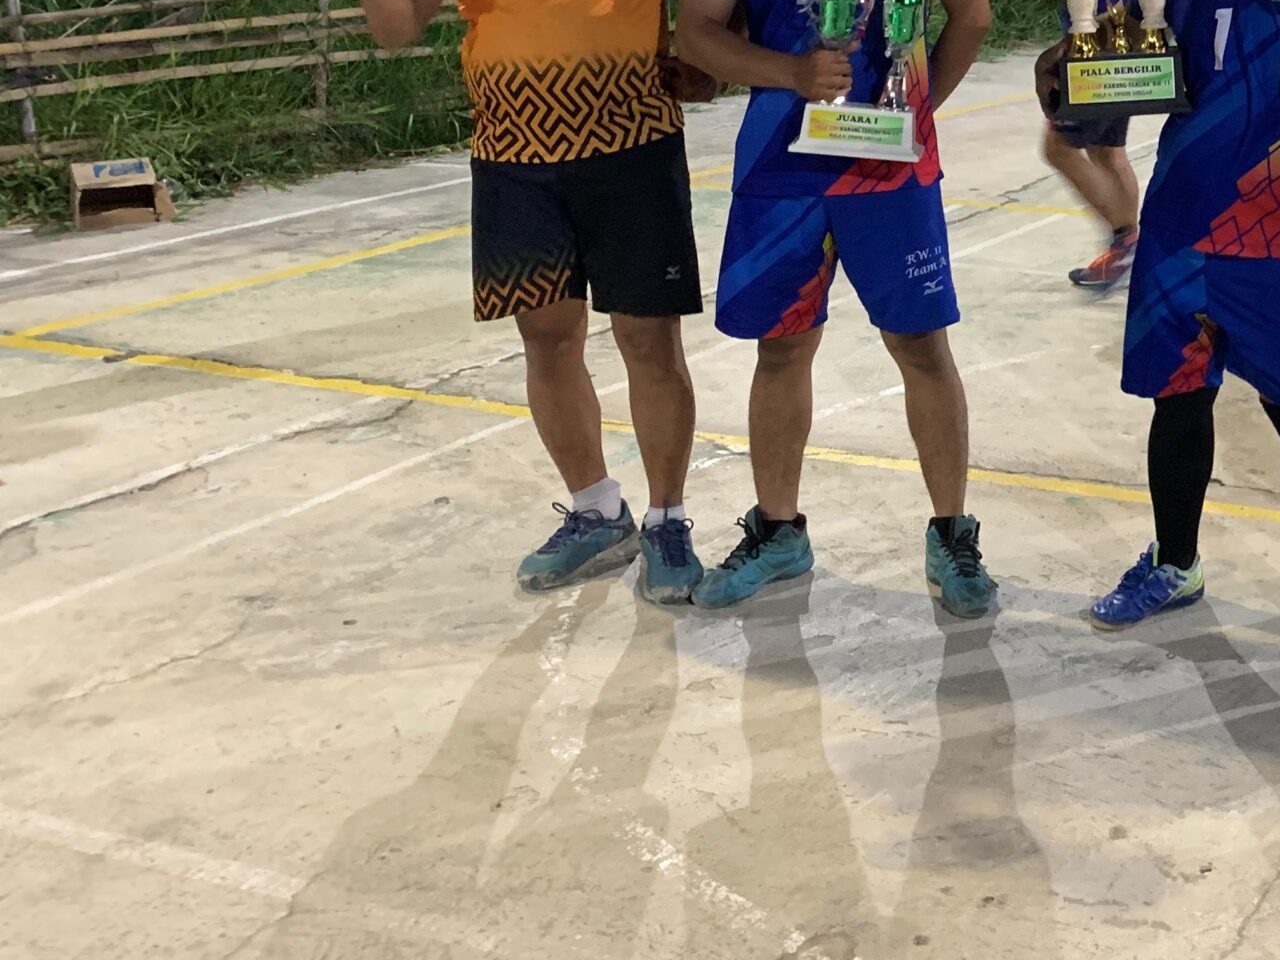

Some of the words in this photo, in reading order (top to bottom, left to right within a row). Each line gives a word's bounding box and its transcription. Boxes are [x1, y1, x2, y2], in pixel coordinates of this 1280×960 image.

[1214, 7, 1234, 71] 1
[1080, 67, 1111, 77] PIALA
[1113, 65, 1163, 75] BERGILIR
[836, 114, 872, 124] JUARA
[905, 262, 938, 279] Team
